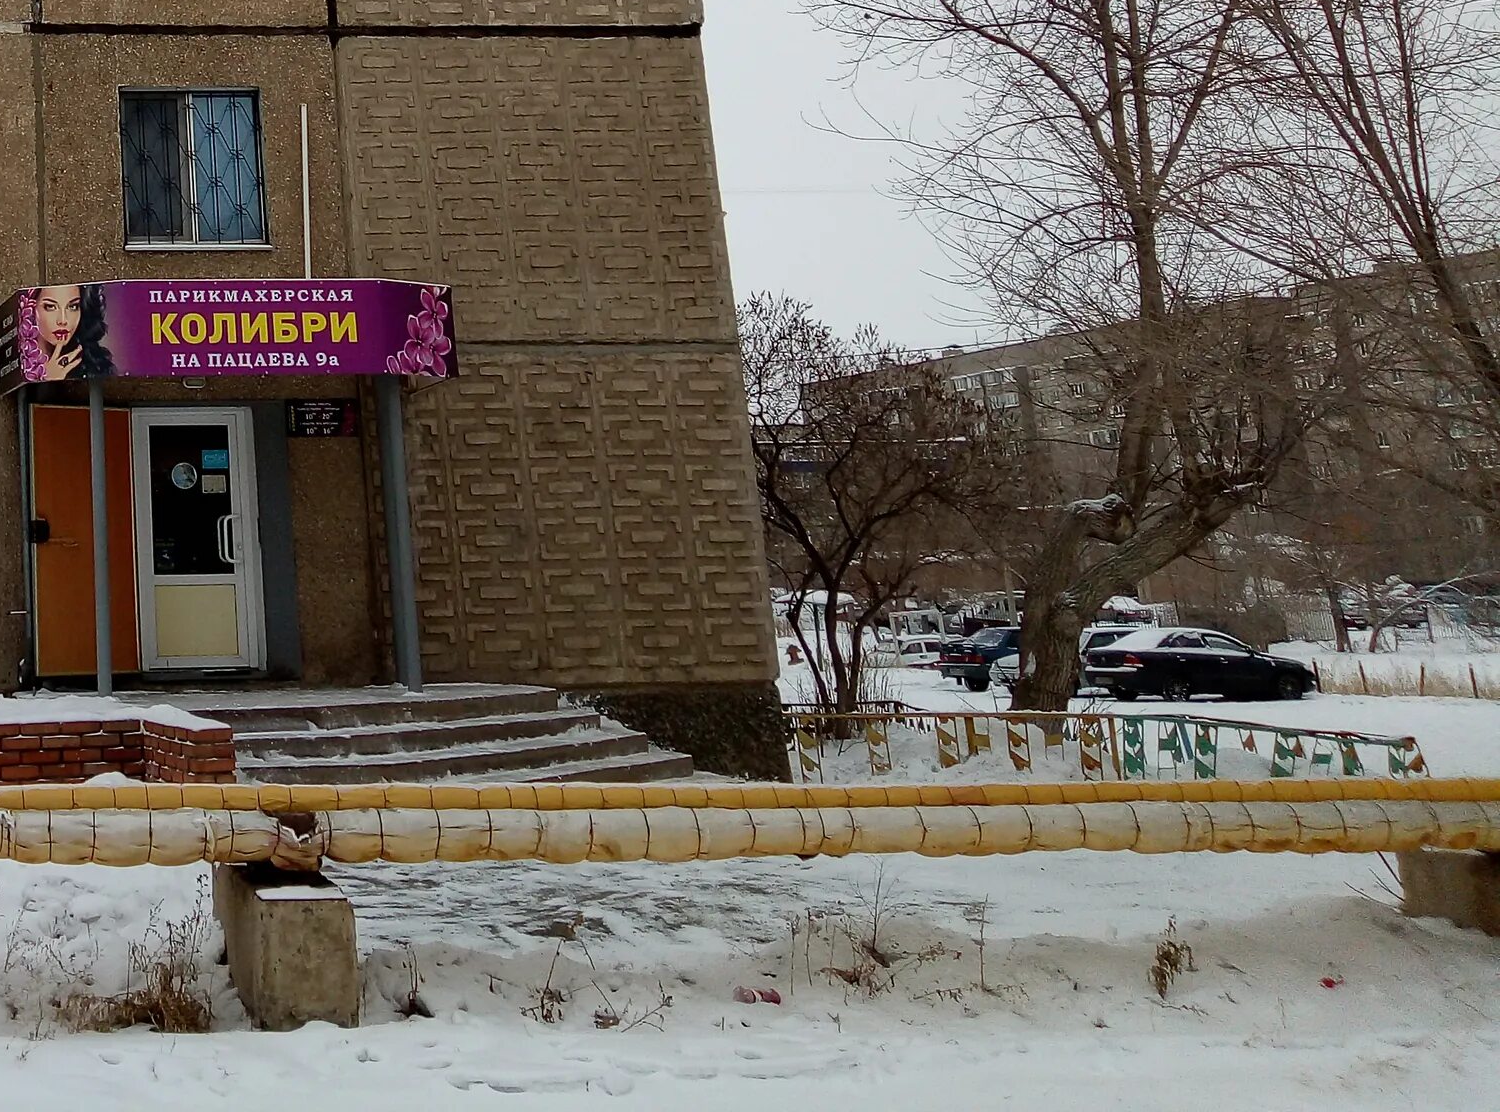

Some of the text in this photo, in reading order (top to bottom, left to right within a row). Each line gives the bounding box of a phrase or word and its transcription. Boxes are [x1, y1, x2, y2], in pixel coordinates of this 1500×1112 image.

[149, 289, 354, 303] ПАРИКМАХЕРСКАЯ
[151, 311, 359, 345] КОЛИБРИ
[171, 352, 340, 369] НА ПАЦАЕВА 9а
